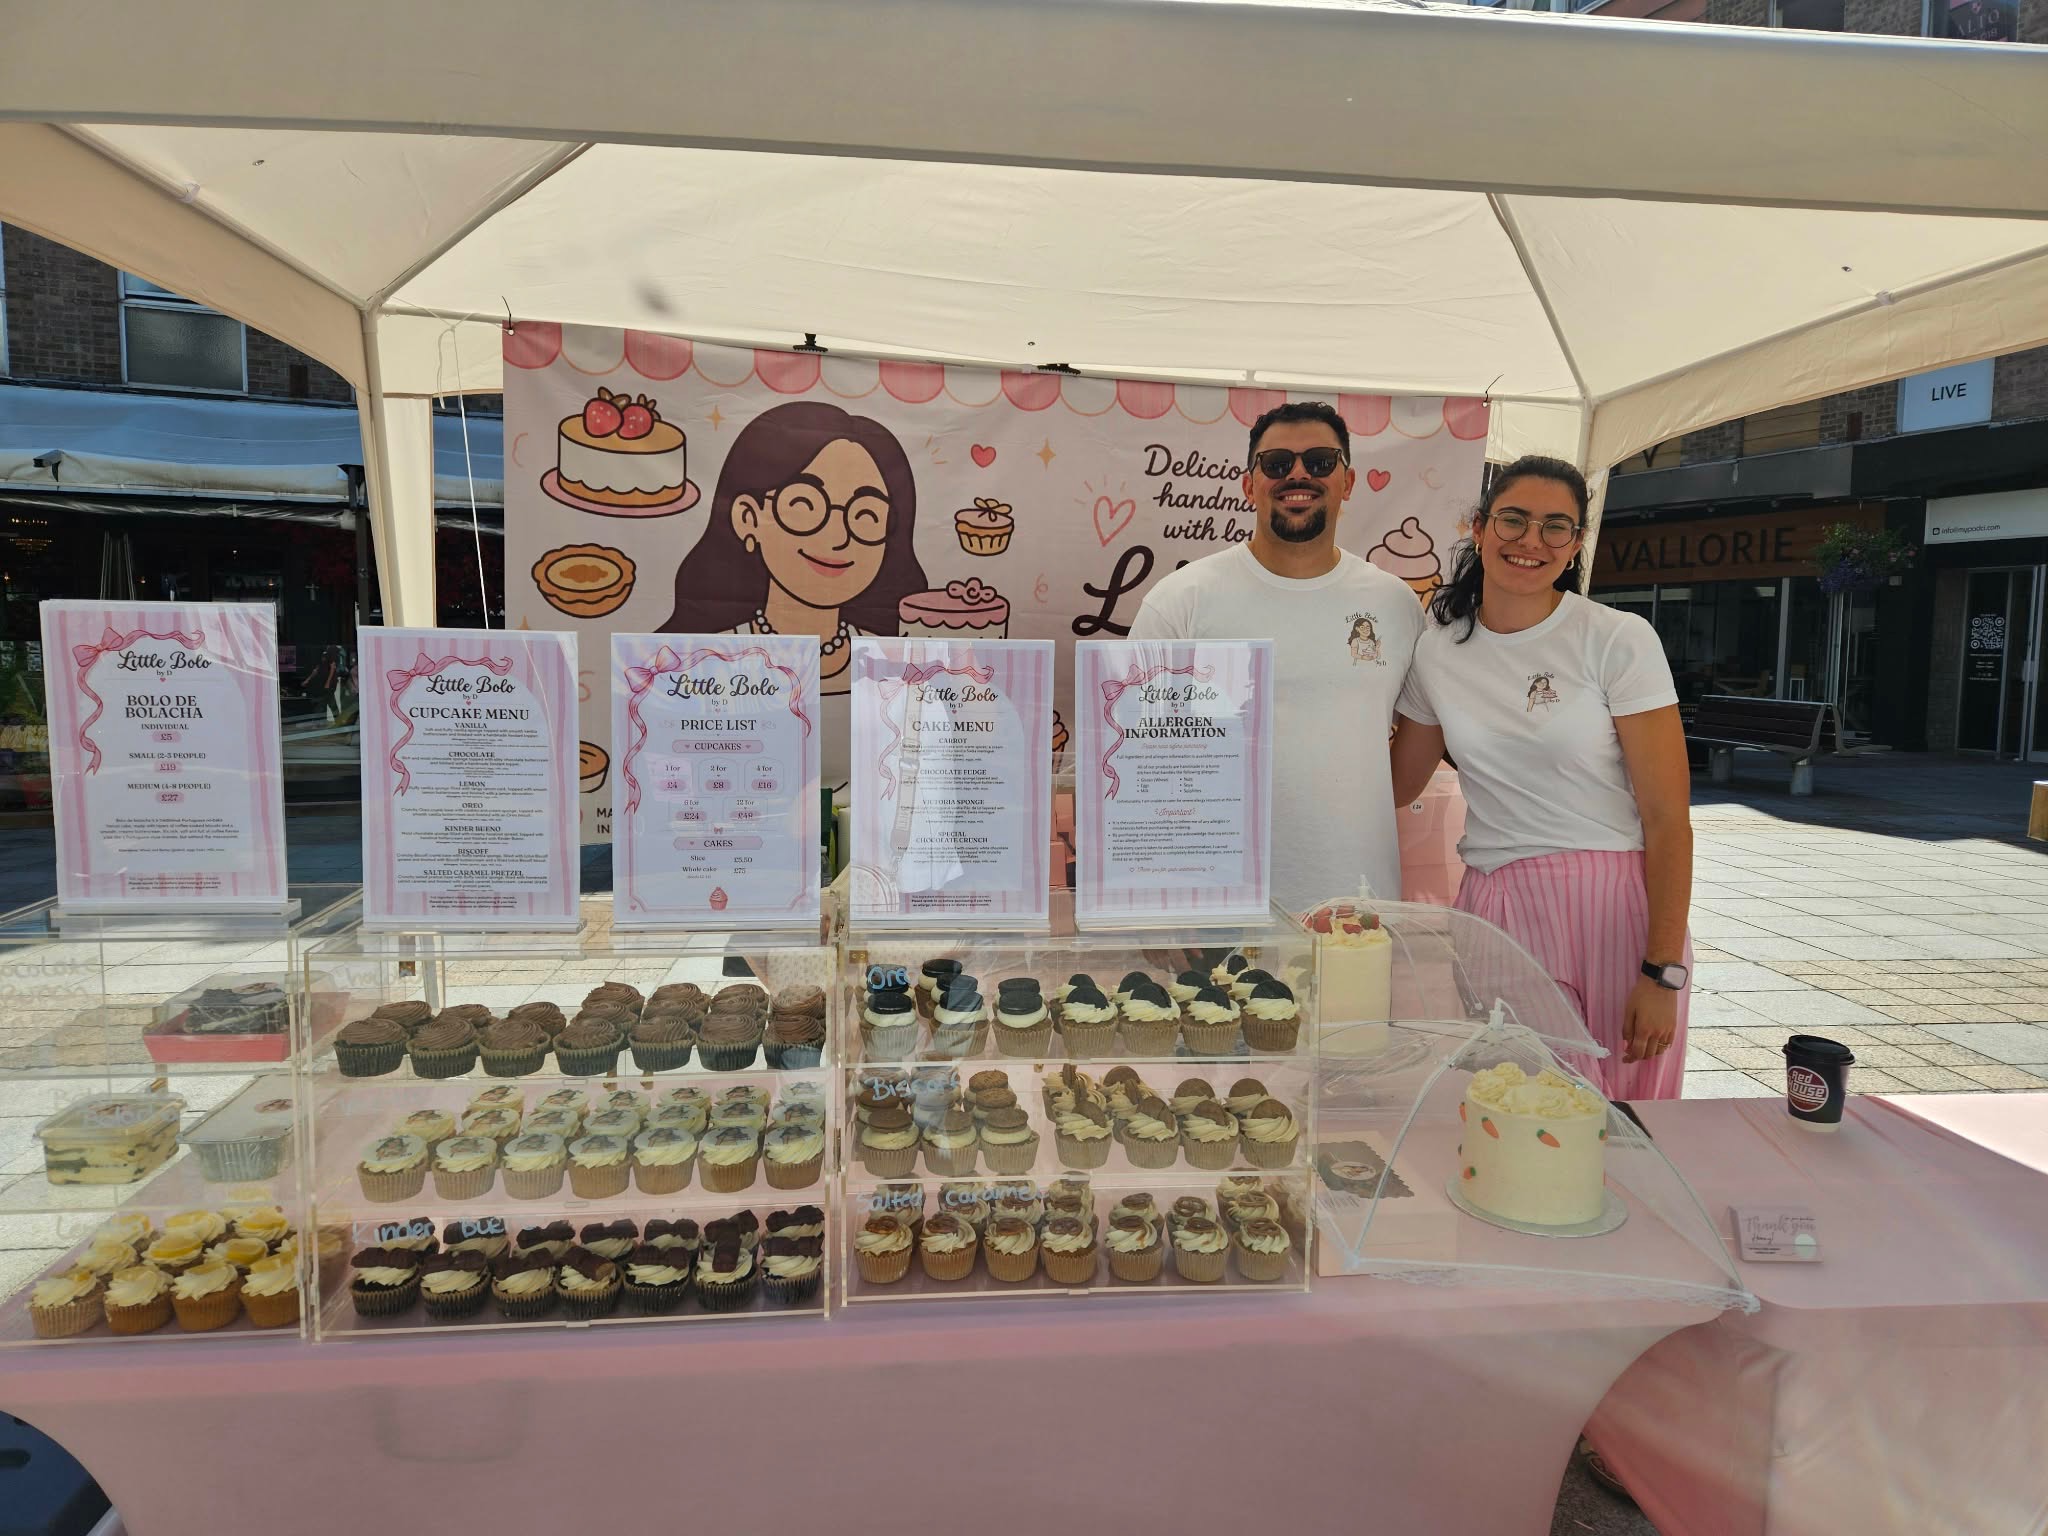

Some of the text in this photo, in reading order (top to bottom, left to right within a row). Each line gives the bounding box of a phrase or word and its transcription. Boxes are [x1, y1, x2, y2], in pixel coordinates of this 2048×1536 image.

[1932, 383, 1967, 402] LIVE
[1163, 517, 1218, 541] with
[1610, 528, 1796, 572] VALLORIE
[117, 650, 212, 671] Little Bolo
[426, 675, 515, 695] Little Bolo
[667, 674, 780, 699] Little Bolo
[126, 695, 197, 706] BOLO DE
[916, 684, 998, 704] Little Bolo
[1139, 684, 1220, 703] Little Bolo
[125, 707, 204, 719] BOLACHA
[409, 707, 529, 720] CUPCAKE MENU
[681, 719, 757, 731] PRICE LIST
[912, 721, 994, 732] CAKE MENU
[1139, 717, 1212, 727] ALLERGEN
[1125, 727, 1226, 738] INFORMATION
[597, 824, 610, 834] IN
[1792, 1071, 1813, 1083] Red
[857, 1188, 923, 1213] Salted
